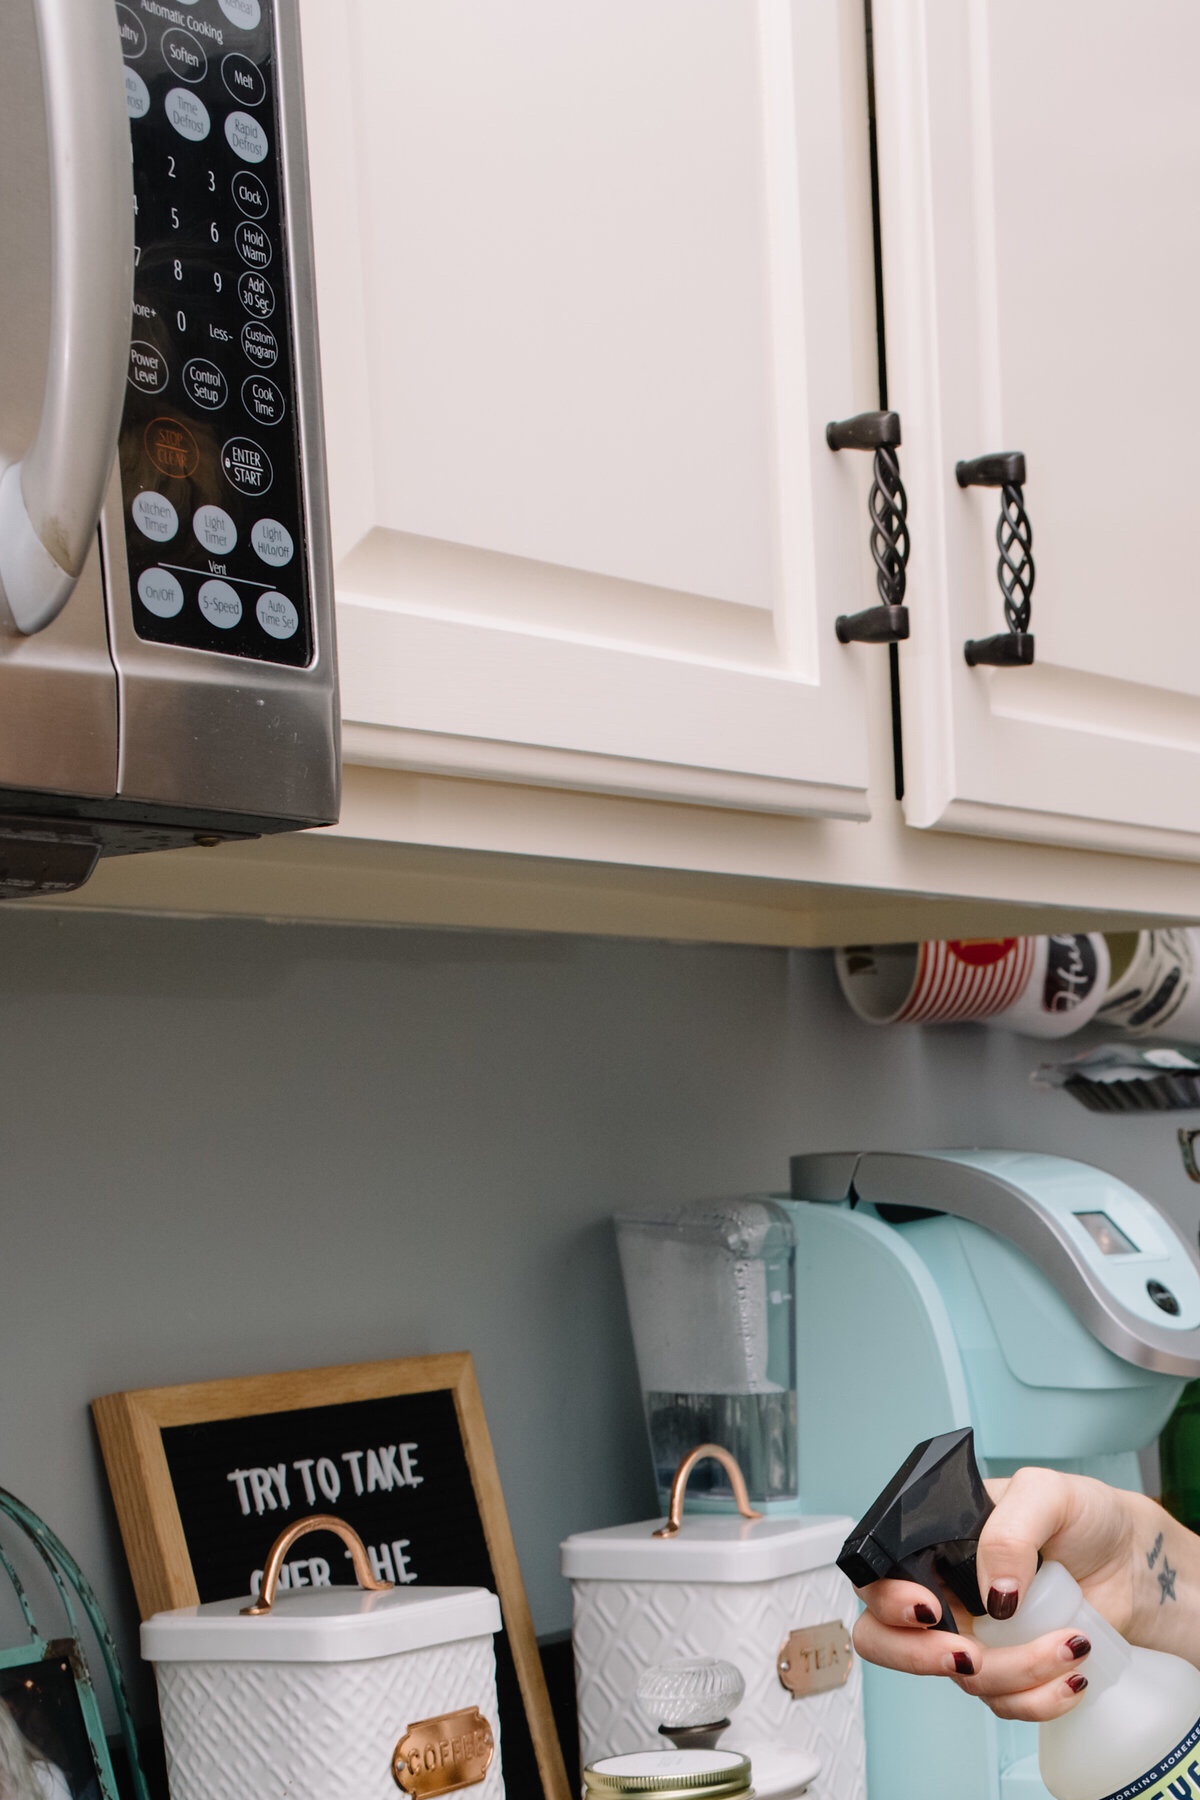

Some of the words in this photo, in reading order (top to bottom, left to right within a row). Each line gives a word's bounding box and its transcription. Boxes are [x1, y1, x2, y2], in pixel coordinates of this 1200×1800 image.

[141, 0, 185, 27] Automatic
[187, 15, 223, 45] Cooking
[120, 24, 139, 44] ultry
[170, 44, 199, 67] Soften
[234, 70, 254, 90] Melt
[177, 95, 198, 114] Time
[173, 111, 204, 134] Defrost
[234, 119, 258, 139] Rapid
[232, 134, 262, 156] Defrost
[168, 156, 176, 178] 2
[208, 171, 216, 192] 3
[239, 186, 262, 206] Clock
[171, 208, 179, 229] 5
[210, 222, 219, 242] 6
[243, 228, 264, 247] Hold
[242, 243, 267, 264] Warm
[174, 259, 183, 281] 8
[213, 272, 222, 293] 9
[248, 276, 265, 294] Add
[243, 290, 253, 305] 30
[177, 311, 187, 331] 0
[245, 326, 275, 346] Custom
[131, 349, 159, 370] Power
[245, 340, 276, 361] Program
[134, 367, 158, 386] Level
[189, 366, 221, 387] Control
[193, 384, 219, 404] Setup
[252, 384, 275, 402] Cook
[253, 399, 275, 418] Time
[159, 429, 184, 446] STOP
[157, 448, 188, 469] CLEAR
[231, 446, 262, 468] ENTER
[234, 468, 263, 487] START
[138, 501, 171, 519] Kitchen
[144, 517, 168, 535] Timer
[203, 514, 225, 533] Light
[204, 530, 227, 547] Timer
[262, 525, 283, 543] Light
[208, 559, 227, 576] Vent
[145, 585, 175, 602] On/Off
[203, 595, 240, 615] 5-Speed
[267, 599, 286, 613] Auto
[260, 611, 280, 625] Time
[282, 615, 295, 629] Set
[227, 1463, 291, 1515] TRY
[293, 1457, 341, 1506] TO
[341, 1442, 424, 1496] TAKE
[344, 1539, 418, 1584] HE
[799, 1641, 840, 1673] TEA
[407, 1730, 486, 1776] COFFEE
